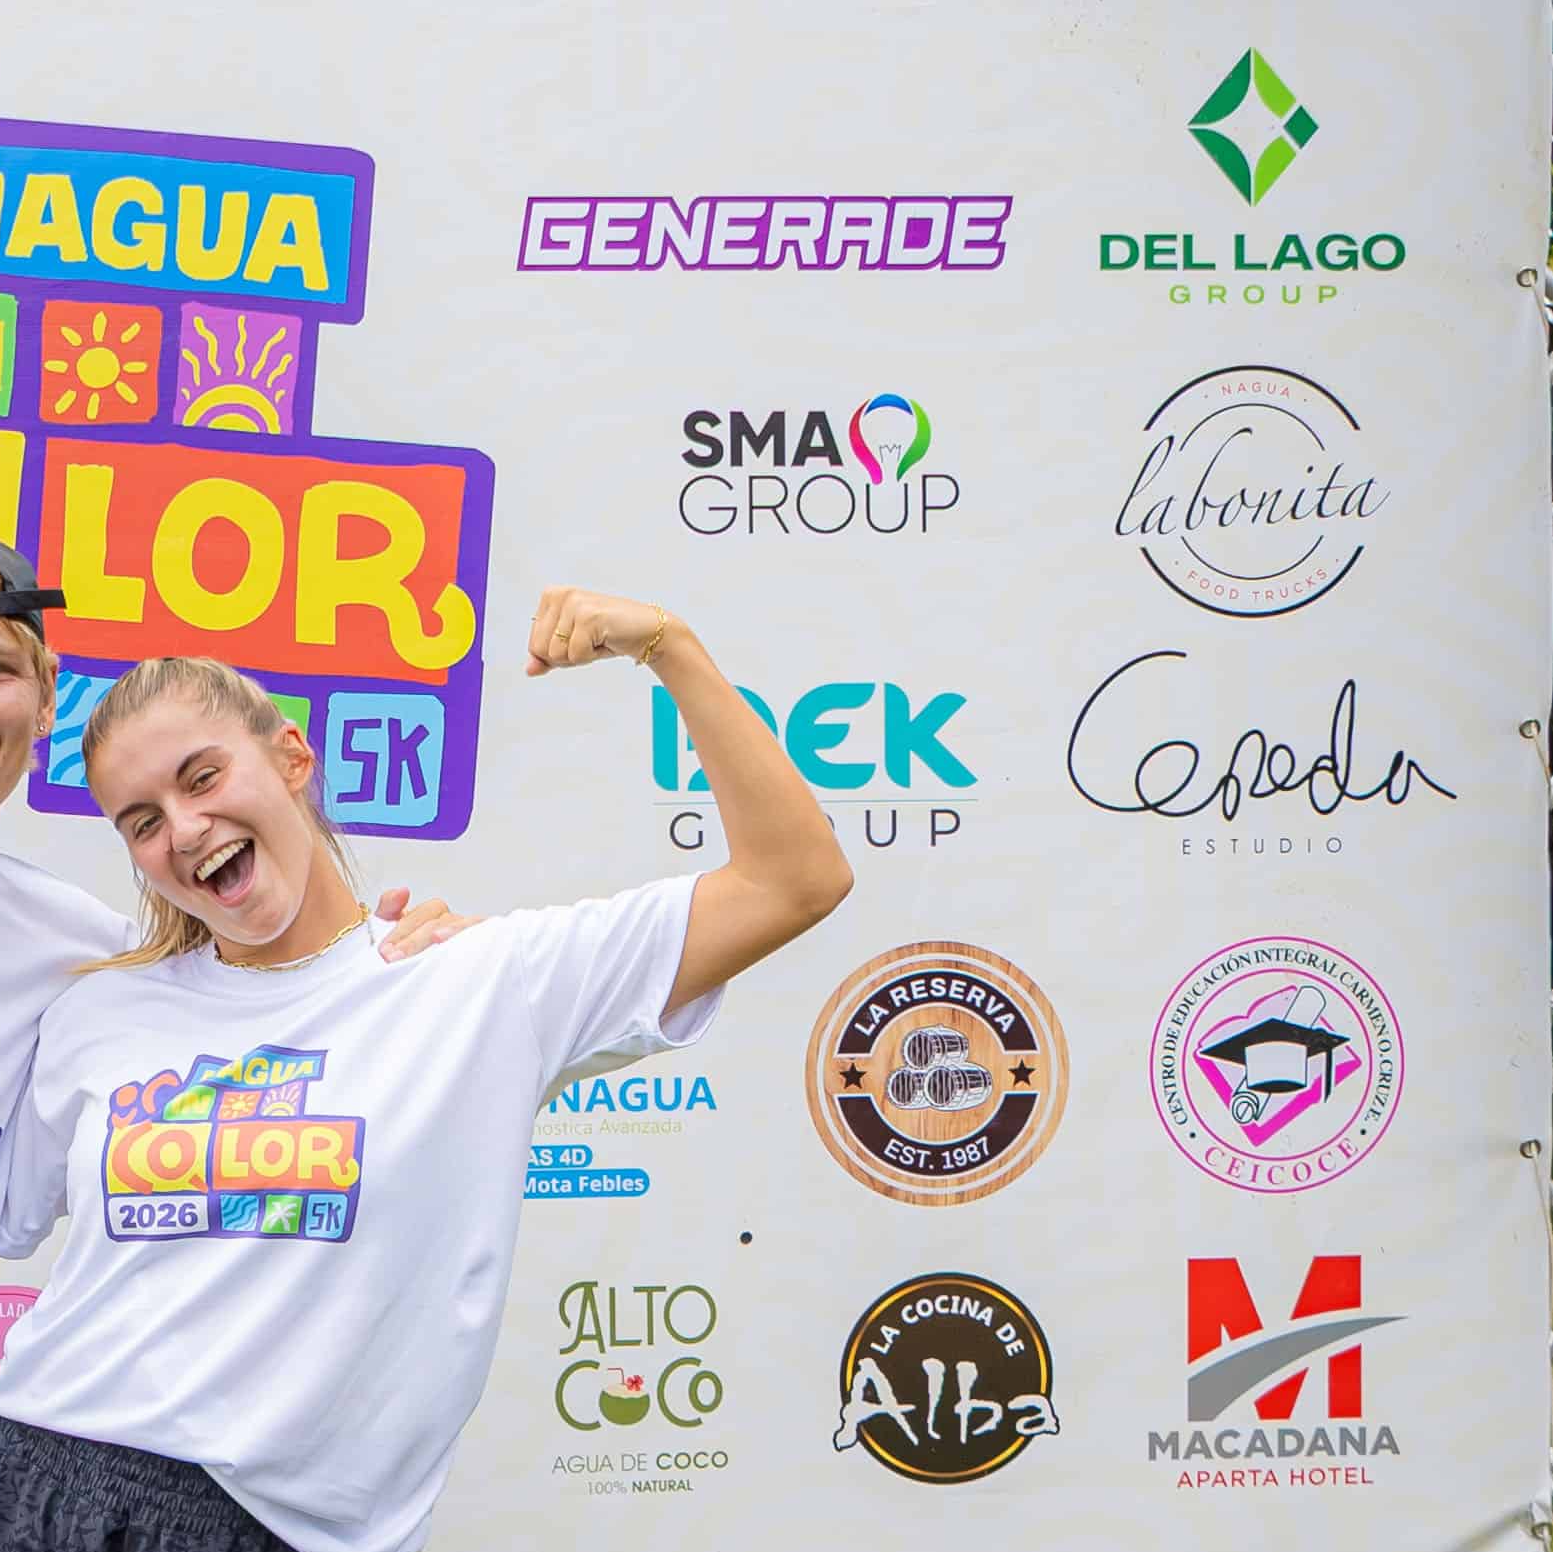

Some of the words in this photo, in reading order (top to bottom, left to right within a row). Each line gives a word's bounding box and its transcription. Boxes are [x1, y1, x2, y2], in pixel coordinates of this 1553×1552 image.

[517, 195, 1014, 271] GENERADE
[1098, 233, 1215, 271] DEL
[1233, 233, 1407, 271] LAGO
[1169, 283, 1339, 305] GROUP
[1221, 381, 1292, 398] NAGUA
[680, 410, 843, 469] SMA
[677, 473, 961, 536] GROUP
[1187, 569, 1240, 601] FOOD
[1251, 567, 1328, 602] TRUCKS
[334, 715, 429, 808] 5K
[669, 809, 961, 851] GUP
[1181, 837, 1343, 856] ESTUDIO
[1254, 947, 1340, 981] INTEGRAL
[854, 1002, 890, 1038] LA
[889, 977, 1017, 1035] RESERVA
[1170, 951, 1253, 1027] EDUCACIÓN
[1338, 970, 1393, 1038] CARMEN
[1161, 1053, 1189, 1127] CENTRO
[111, 1119, 360, 1195] COLOR
[882, 1137, 936, 1170] EST.
[940, 1135, 992, 1171] 1987
[1203, 1137, 1360, 1186] CEICOCE
[578, 1175, 646, 1194] Febles
[118, 1202, 199, 1230] 2026
[309, 1201, 342, 1232] 5K
[558, 1280, 718, 1356] ALTO
[869, 1323, 901, 1356] LA
[900, 1294, 995, 1328] COCINA
[995, 1322, 1026, 1358] DE
[833, 1357, 1061, 1452] Alba
[550, 1453, 615, 1475] AGUA
[620, 1452, 648, 1472] DE
[655, 1450, 730, 1471] COCO
[1147, 1423, 1402, 1463] MACADANA
[586, 1480, 628, 1496] 100%
[631, 1478, 696, 1495] NATURAL
[1176, 1465, 1281, 1490] APARTA
[1288, 1463, 1375, 1488] HOTEL
